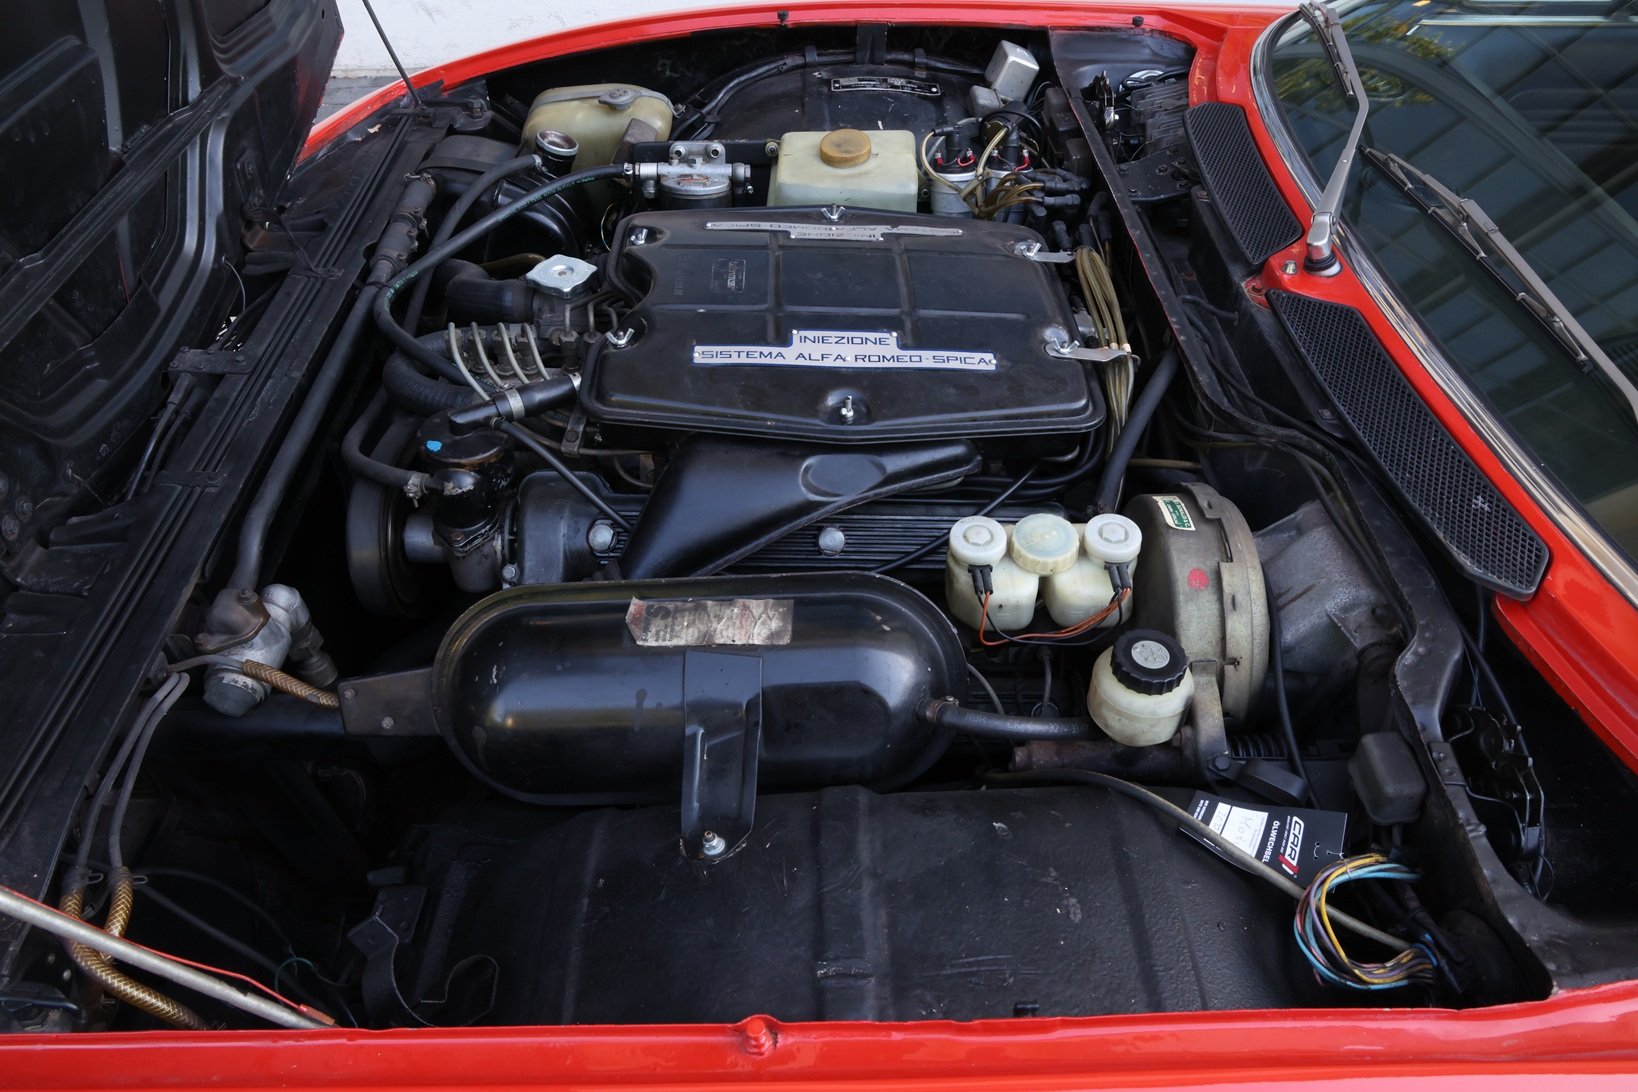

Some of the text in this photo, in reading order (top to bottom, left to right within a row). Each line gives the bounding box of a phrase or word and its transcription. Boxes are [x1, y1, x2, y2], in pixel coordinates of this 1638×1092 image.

[799, 334, 890, 346] INIEZIONE
[700, 350, 786, 361] SISTEMA
[795, 352, 846, 362] ALFA
[854, 354, 923, 364] ROMEO
[932, 355, 991, 366] SPICA
[1261, 820, 1281, 863] ÖLWECHSEL
